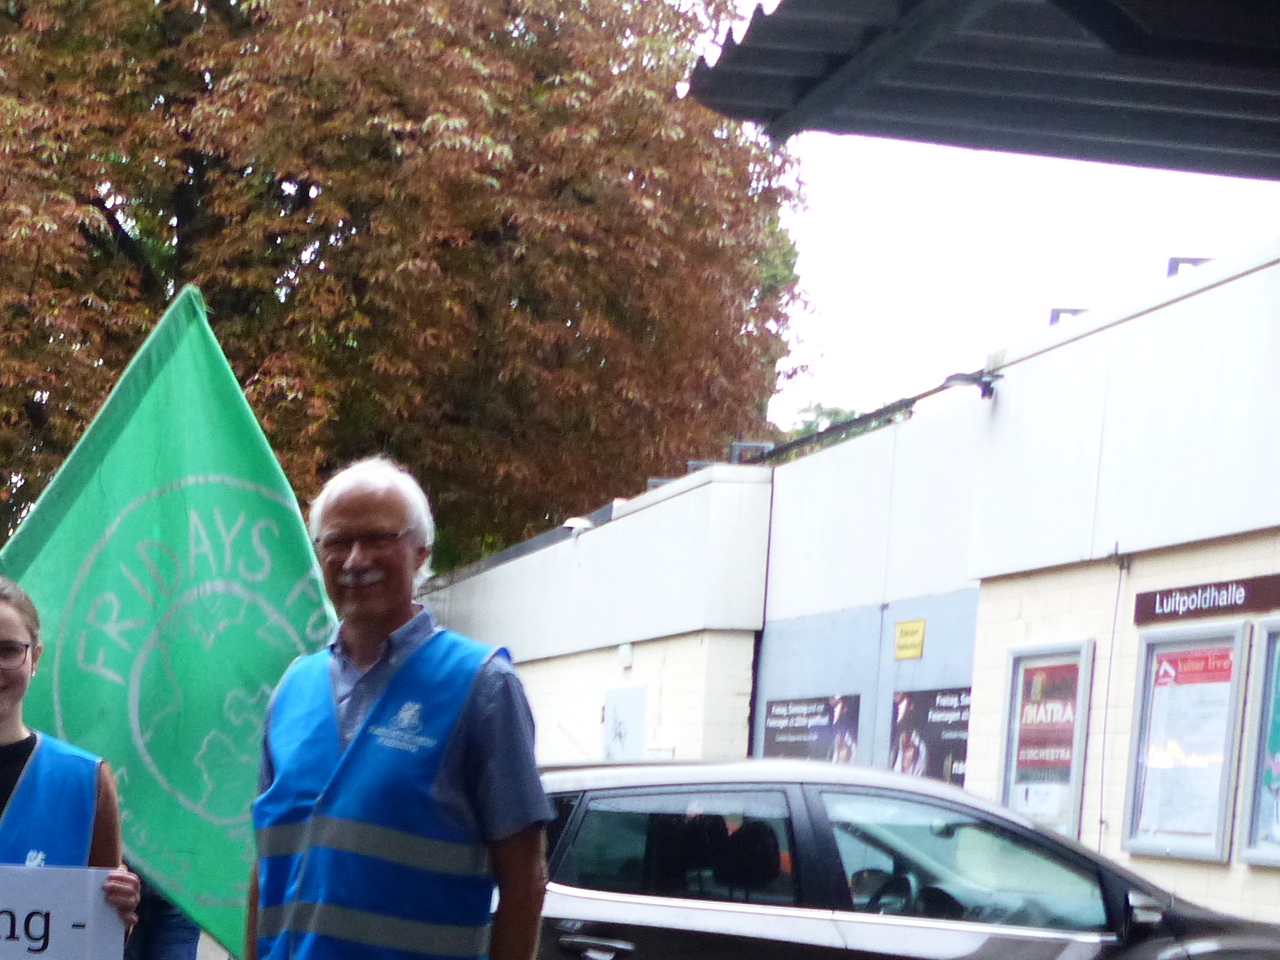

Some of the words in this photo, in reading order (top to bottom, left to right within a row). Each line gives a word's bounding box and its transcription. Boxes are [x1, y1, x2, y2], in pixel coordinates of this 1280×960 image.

[76, 508, 279, 685] FRIDAYS
[1154, 582, 1246, 615] Luitpoldhalle
[70, 922, 87, 930] -
